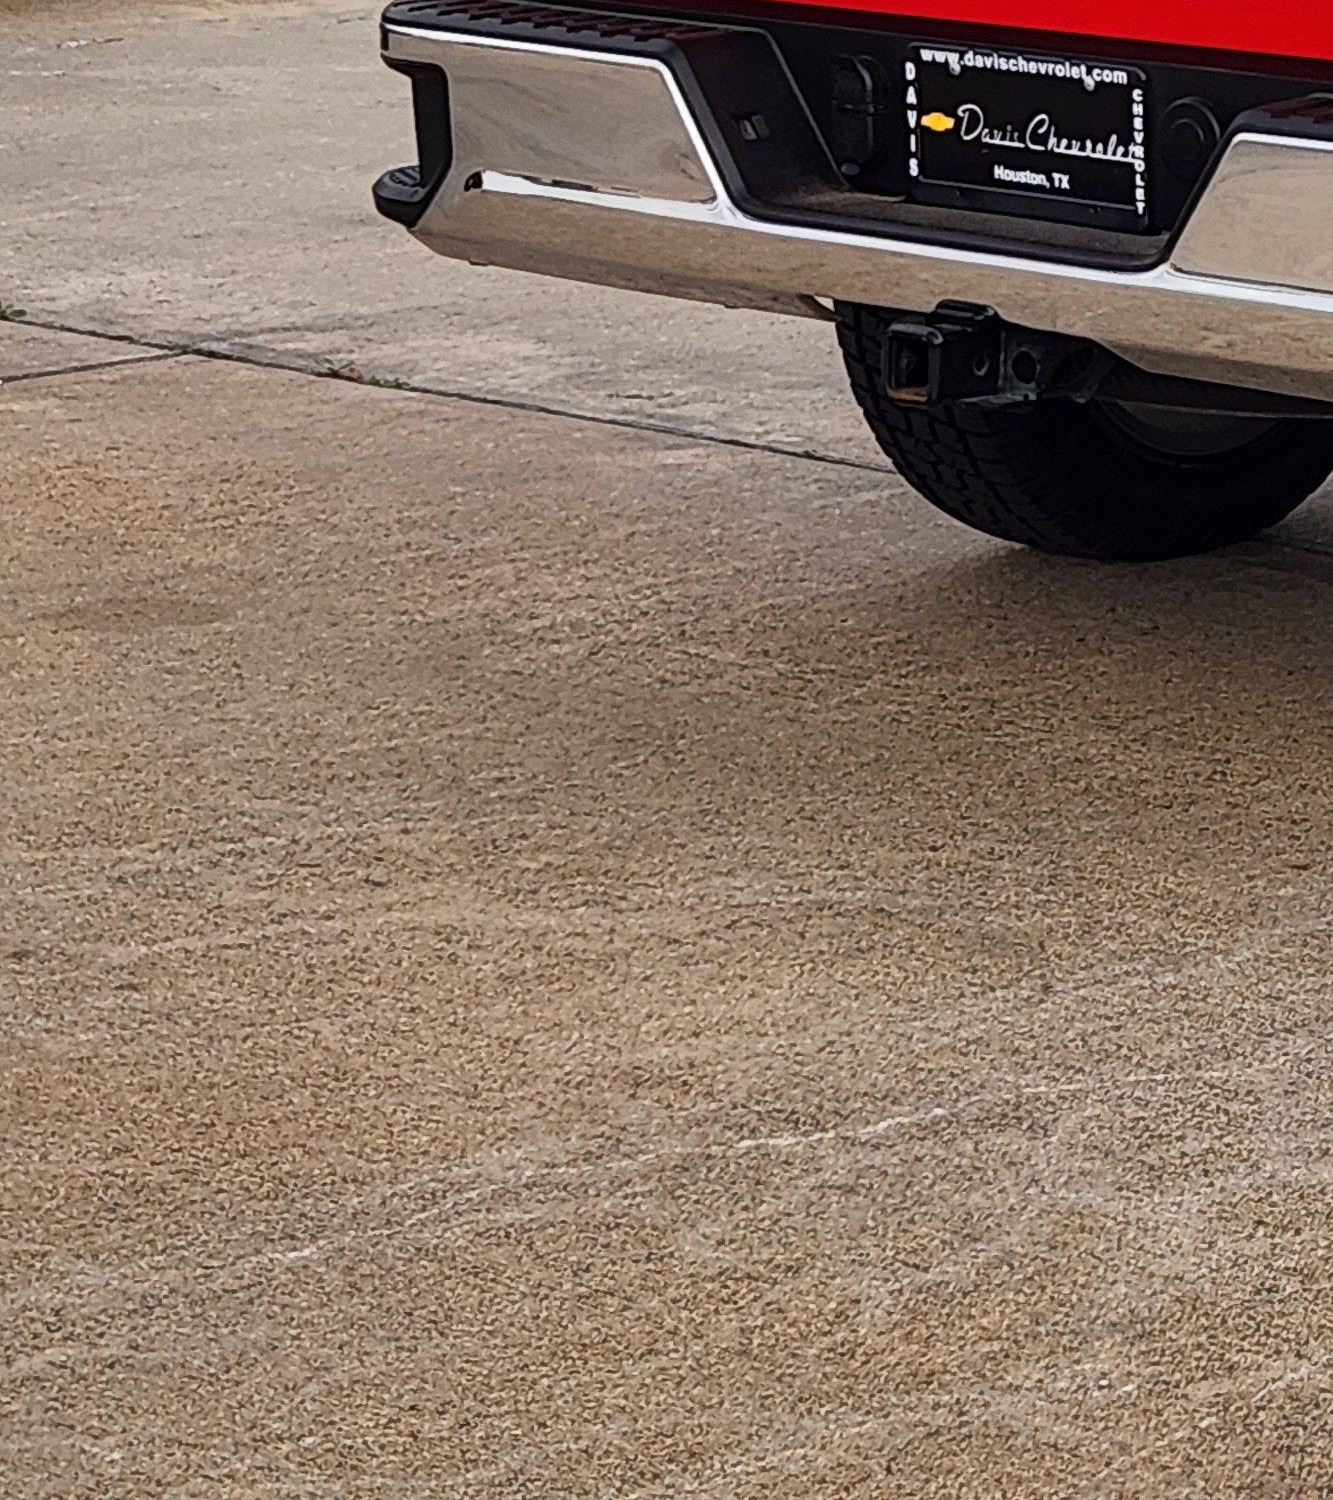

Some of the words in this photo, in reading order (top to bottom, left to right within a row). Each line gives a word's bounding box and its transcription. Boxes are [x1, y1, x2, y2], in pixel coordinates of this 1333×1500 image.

[905, 62, 919, 177] DAVIS
[957, 103, 1026, 148] Davis
[1026, 113, 1137, 163] Chevrolet
[1132, 88, 1146, 214] CHEVROLET
[994, 164, 1050, 188] Houston,
[1052, 172, 1070, 190] TX
